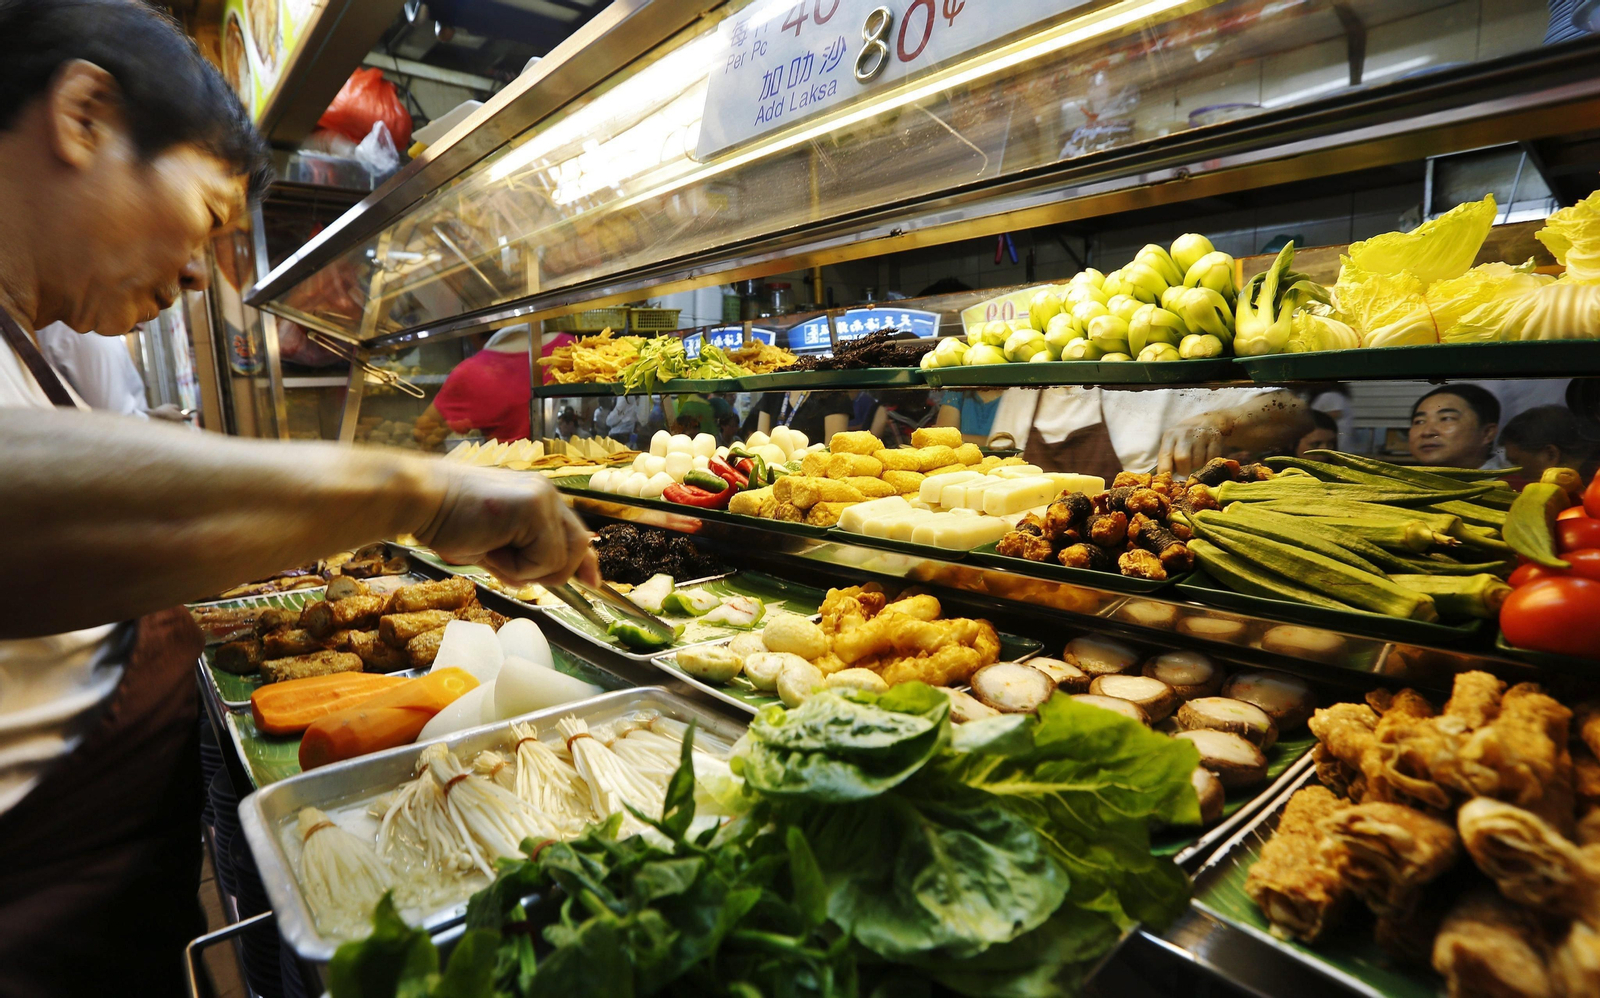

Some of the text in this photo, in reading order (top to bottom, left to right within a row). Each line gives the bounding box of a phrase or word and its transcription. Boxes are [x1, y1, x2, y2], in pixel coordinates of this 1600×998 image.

[725, 40, 768, 74] Per Pc
[754, 79, 838, 127] Add Laksa
